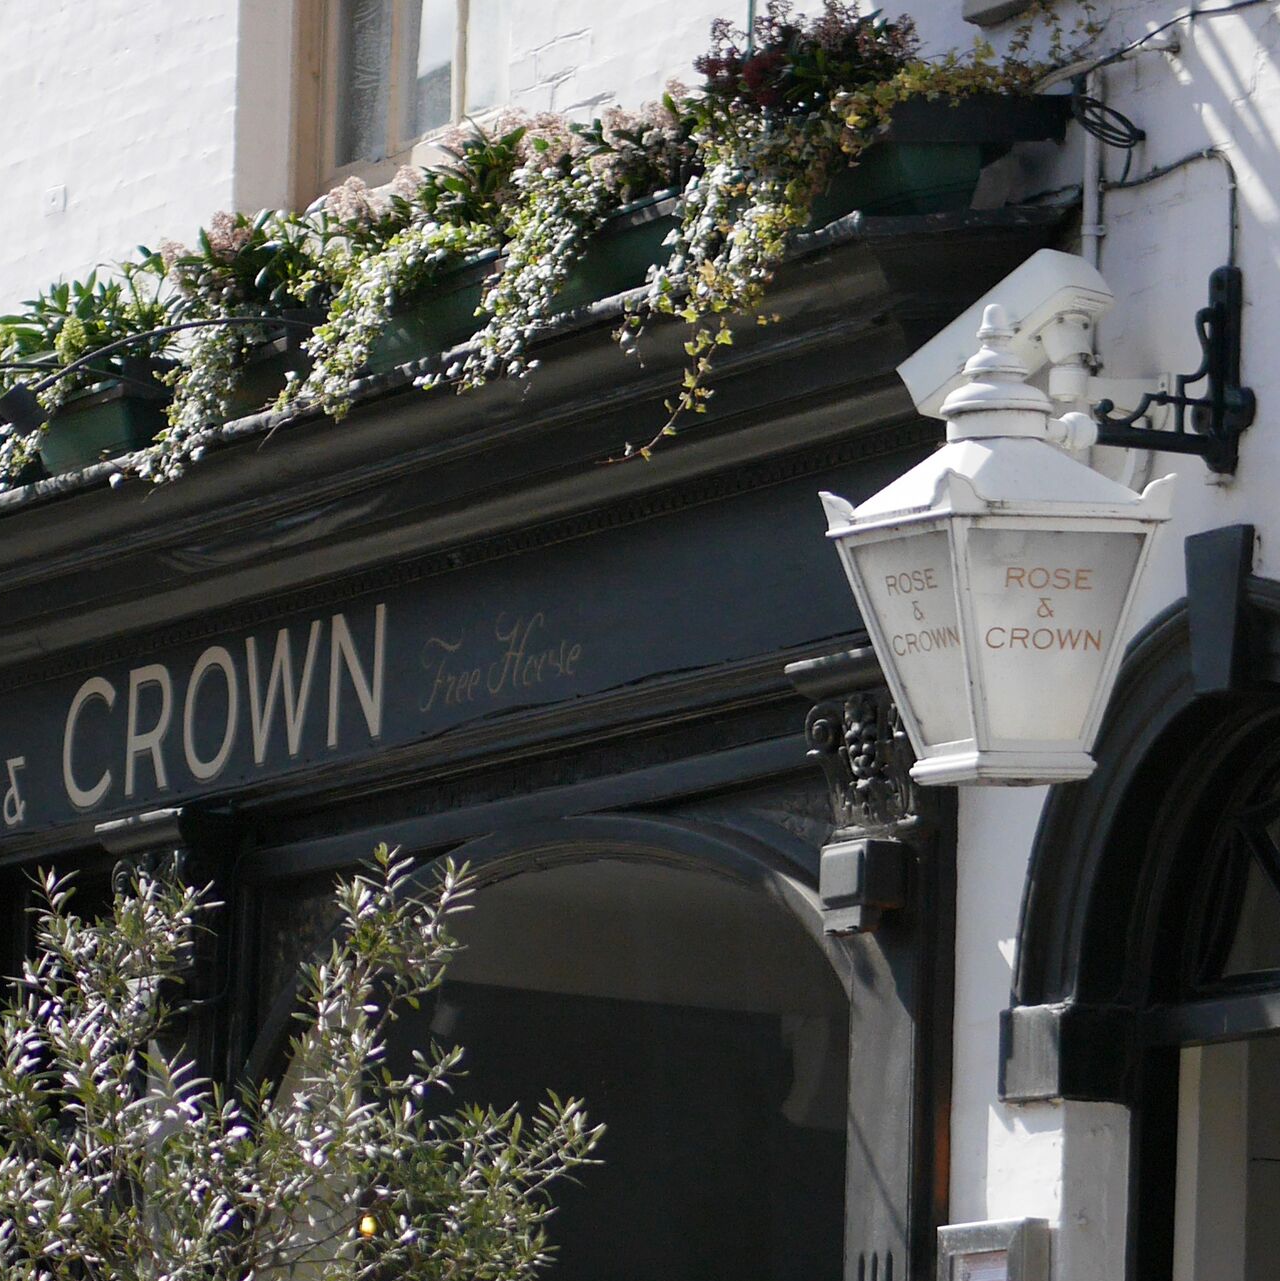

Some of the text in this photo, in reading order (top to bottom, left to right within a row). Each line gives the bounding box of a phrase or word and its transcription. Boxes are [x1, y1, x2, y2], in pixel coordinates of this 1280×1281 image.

[885, 568, 938, 596] ROSE
[1004, 567, 1094, 590] ROSE
[912, 600, 925, 620] &
[1037, 597, 1054, 617] &
[892, 626, 961, 657] CROWN
[985, 626, 1103, 651] CROWN
[419, 610, 582, 712] Free House
[2, 756, 26, 826] &
[62, 603, 387, 808] CROWN
